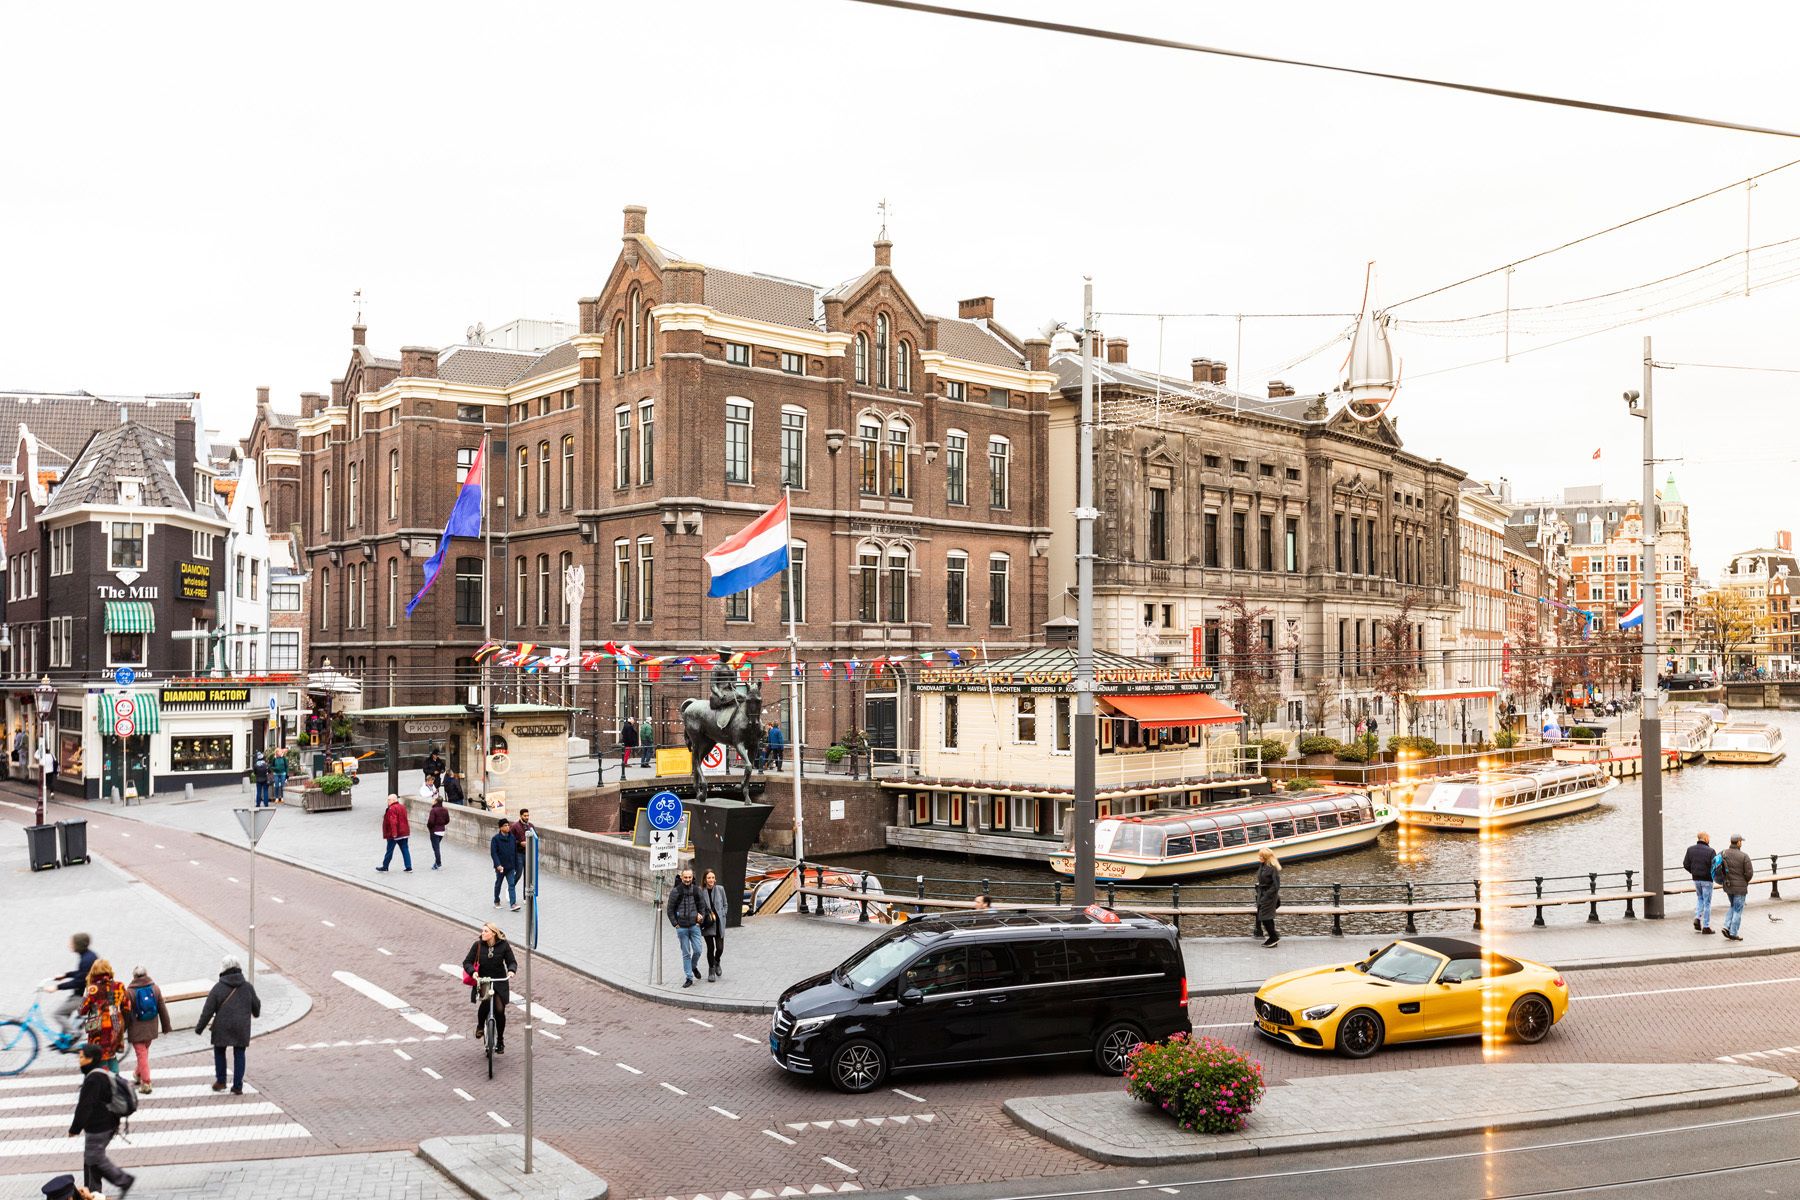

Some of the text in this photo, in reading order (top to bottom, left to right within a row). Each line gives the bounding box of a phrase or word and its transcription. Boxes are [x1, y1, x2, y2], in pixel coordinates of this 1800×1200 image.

[181, 563, 210, 576] DIAMOND
[184, 577, 208, 587] wholesale
[97, 586, 158, 598] The Mill
[184, 587, 208, 598] TAX-FREE
[920, 669, 1014, 684] RONDVAART
[1096, 667, 1171, 682] RONDVAART
[163, 690, 248, 702] DIAMOND FACTORY
